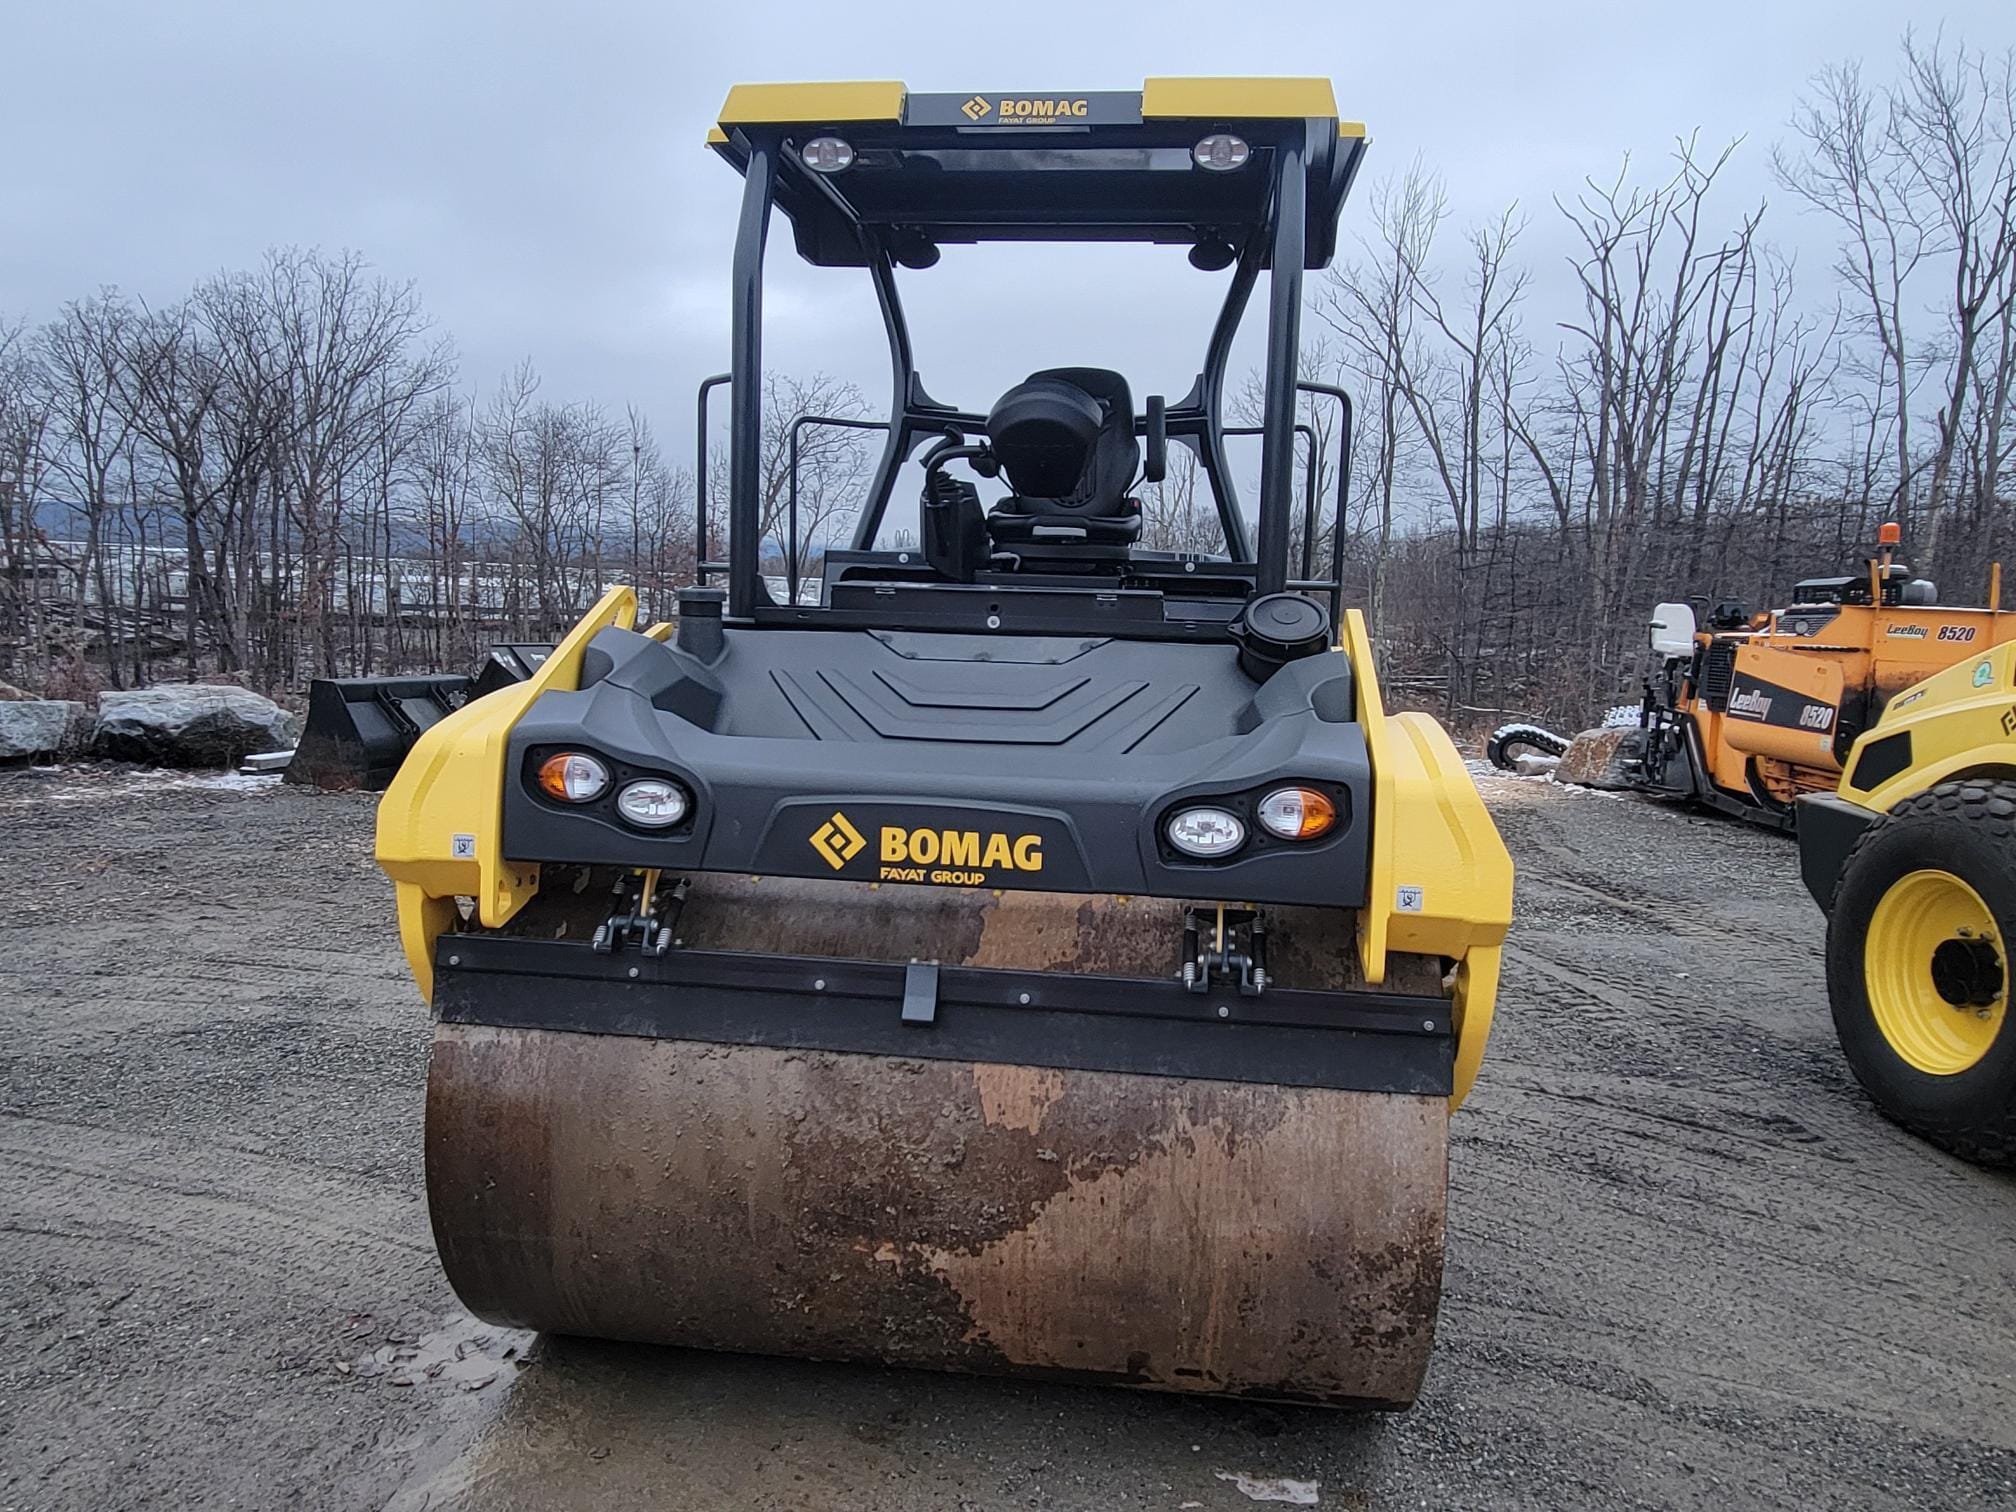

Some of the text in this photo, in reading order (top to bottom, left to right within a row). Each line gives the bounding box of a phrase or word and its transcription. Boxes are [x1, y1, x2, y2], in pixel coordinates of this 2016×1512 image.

[1000, 100, 1088, 116] BOMAG
[1887, 624, 1976, 642] LeeBoy 8520
[1729, 687, 1834, 729] LeeBoy 8520
[880, 826, 1042, 871] BOMAG
[879, 867, 985, 885] FAYAT GROUP
